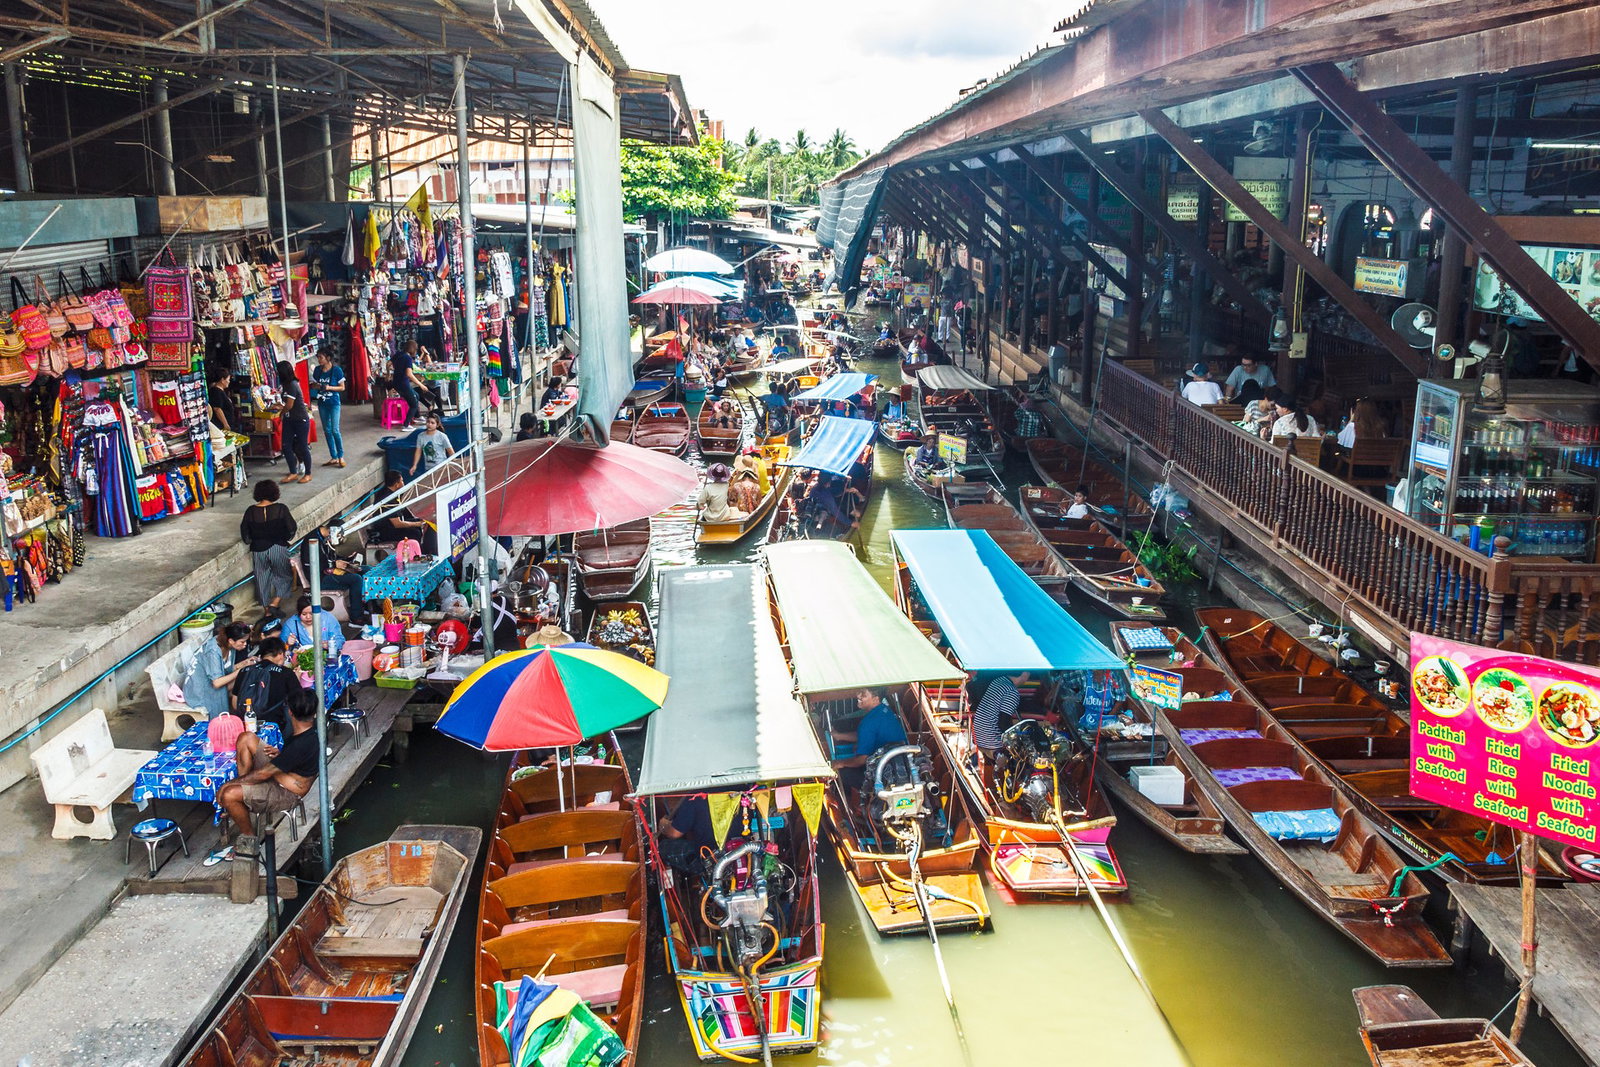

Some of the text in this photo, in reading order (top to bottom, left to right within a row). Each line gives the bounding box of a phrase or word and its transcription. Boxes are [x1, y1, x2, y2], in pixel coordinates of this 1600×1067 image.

[1418, 720, 1466, 745] Padthai
[1426, 743, 1456, 761] with
[1486, 737, 1520, 760] Fried
[1416, 758, 1466, 784] Seafood
[1488, 757, 1517, 778] Rice
[1551, 753, 1589, 777] Fried
[1486, 778, 1517, 799] with
[1543, 774, 1596, 799] Noodle
[1474, 793, 1528, 823] Seafood
[1551, 796, 1584, 818] with
[1537, 813, 1596, 842] Seafood
[400, 845, 422, 857] J 13
